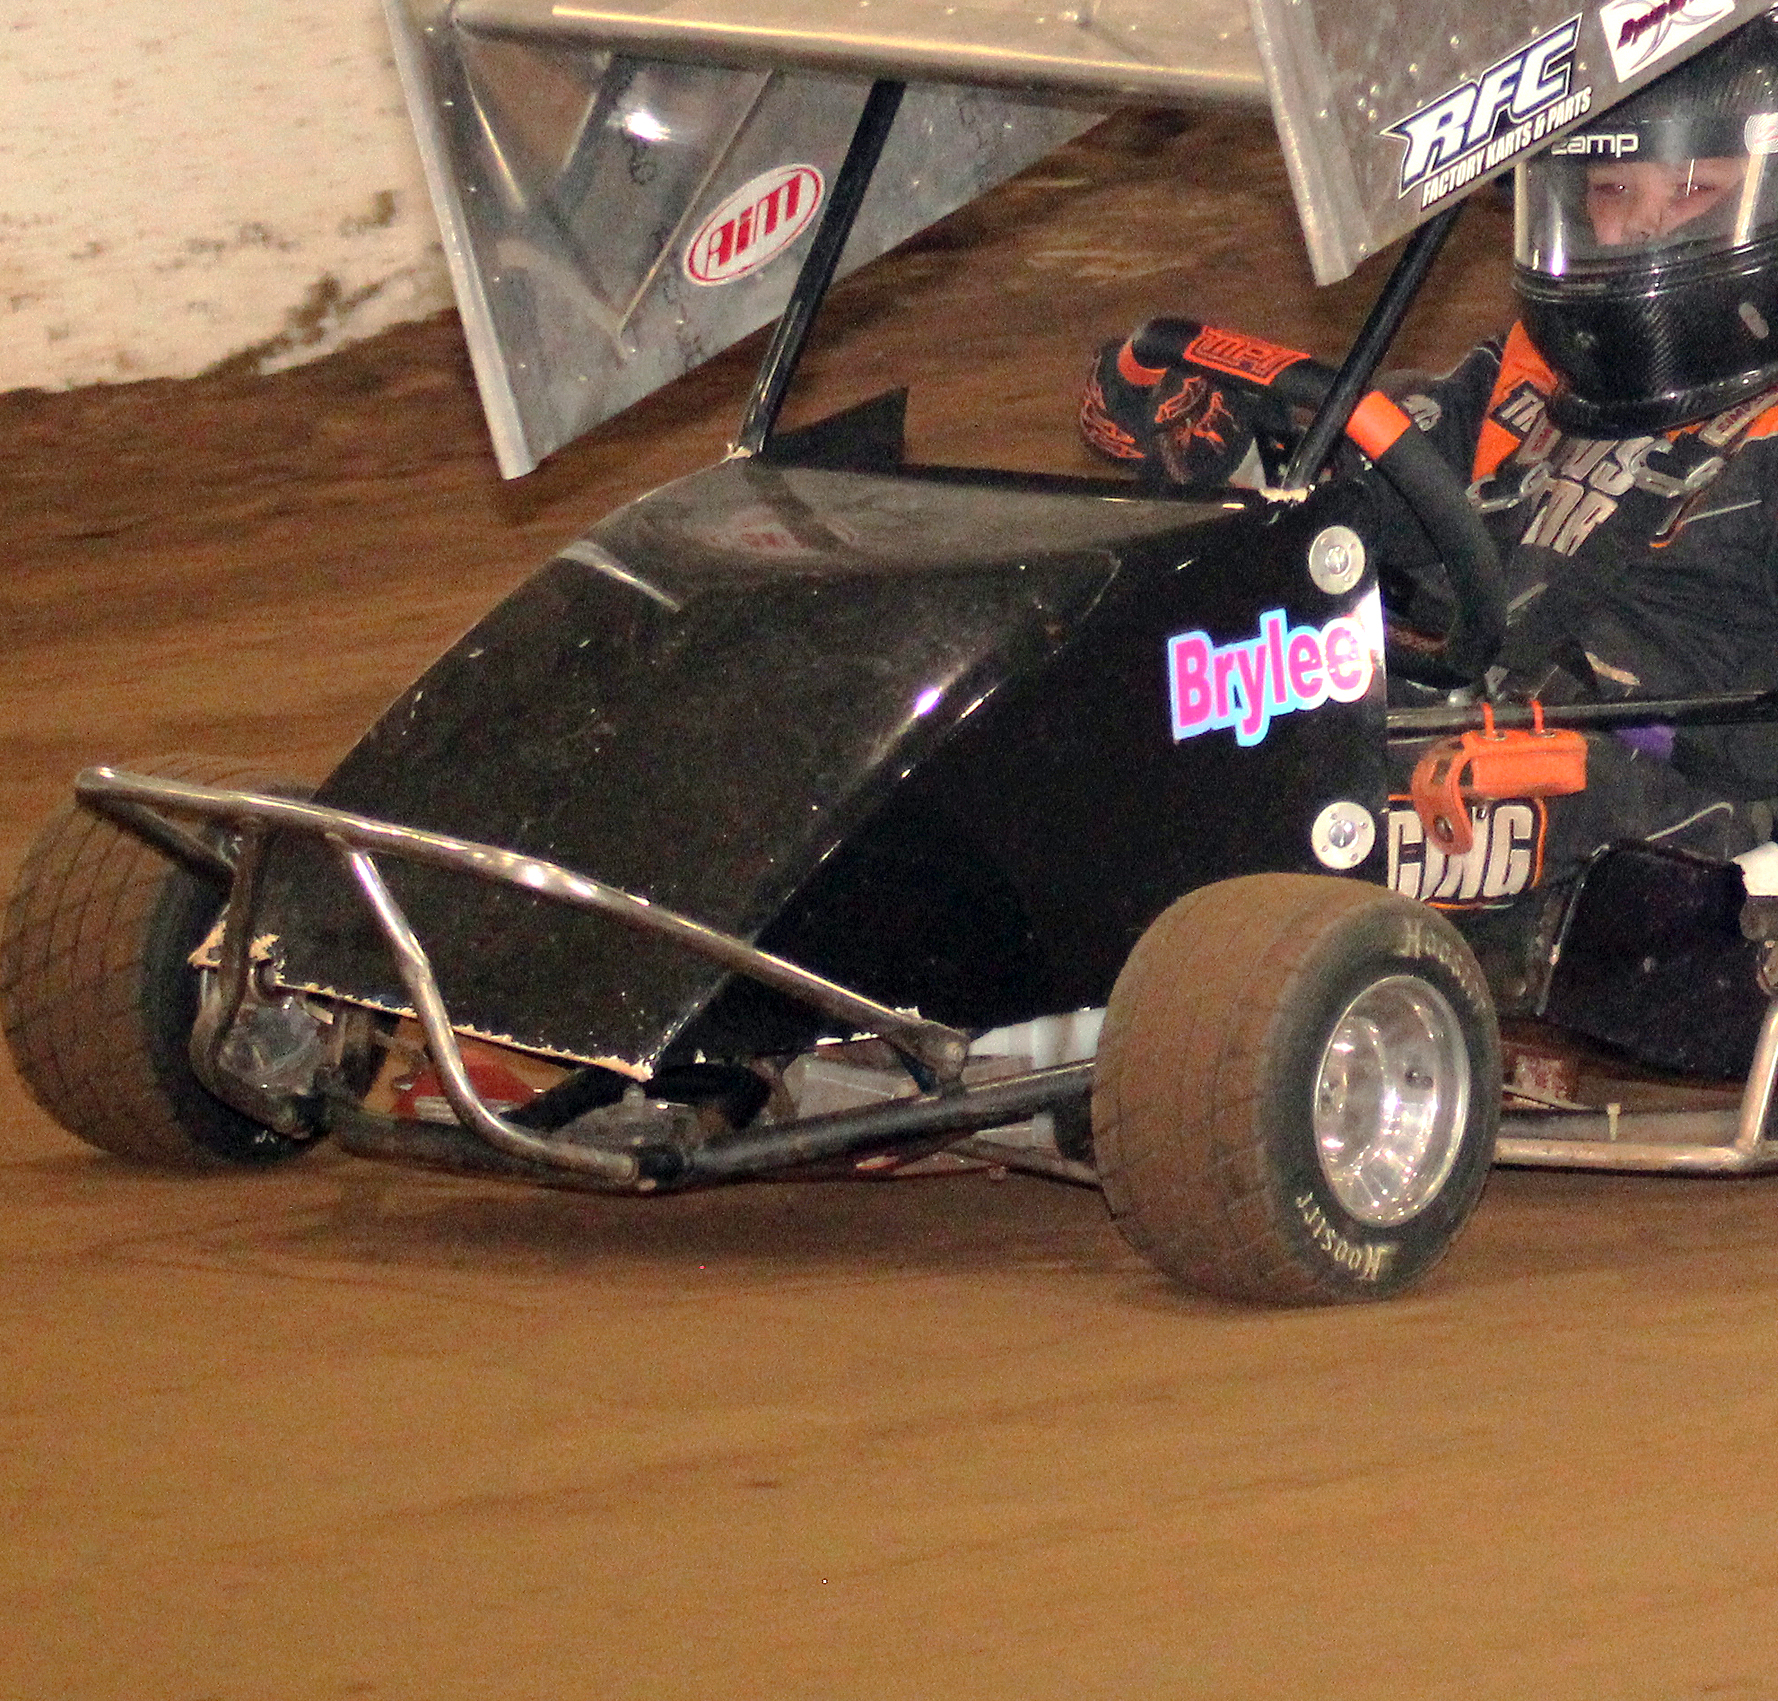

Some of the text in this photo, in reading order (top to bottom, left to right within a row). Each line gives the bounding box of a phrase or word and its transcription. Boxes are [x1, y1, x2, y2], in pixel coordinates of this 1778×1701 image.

[1380, 12, 1584, 200] RFC
[1420, 151, 1485, 212] FACTORY
[1480, 126, 1533, 176] KARTS
[1545, 85, 1593, 140] PARTS
[1169, 610, 1372, 744] Brylee
[1296, 1192, 1396, 1282] Hoosier
